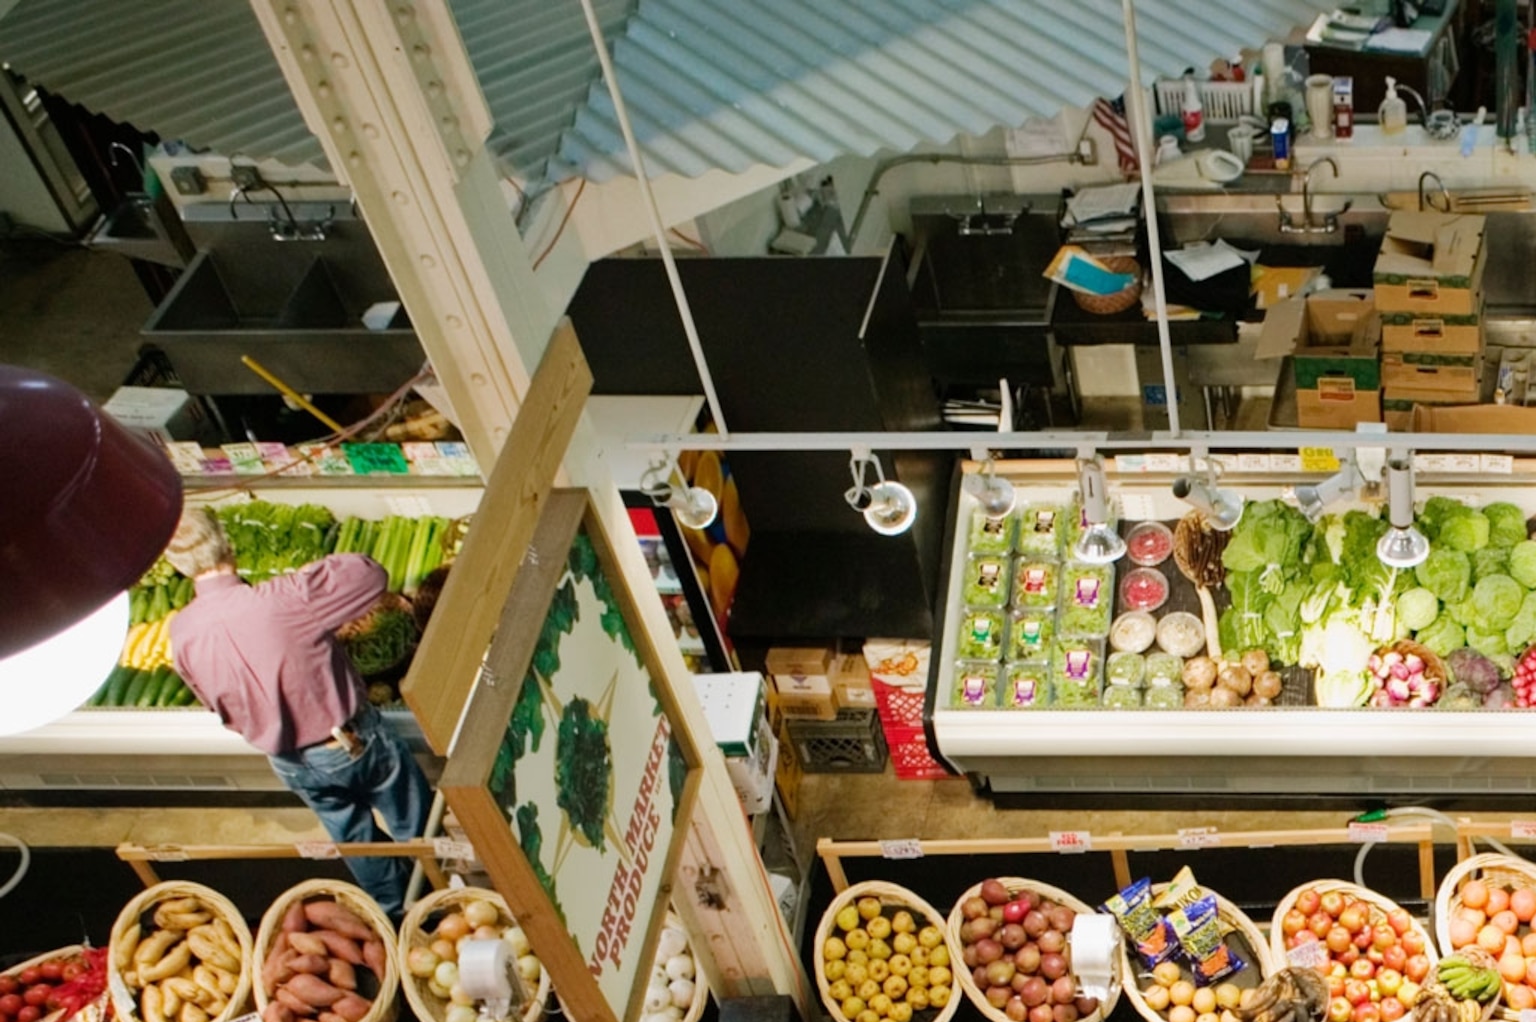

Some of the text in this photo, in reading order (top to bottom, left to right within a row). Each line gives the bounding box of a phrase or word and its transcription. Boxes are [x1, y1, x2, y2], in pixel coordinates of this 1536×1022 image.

[588, 858, 630, 981] NORTH
[624, 715, 670, 856] MARKET
[608, 803, 661, 972] PRODUCE
